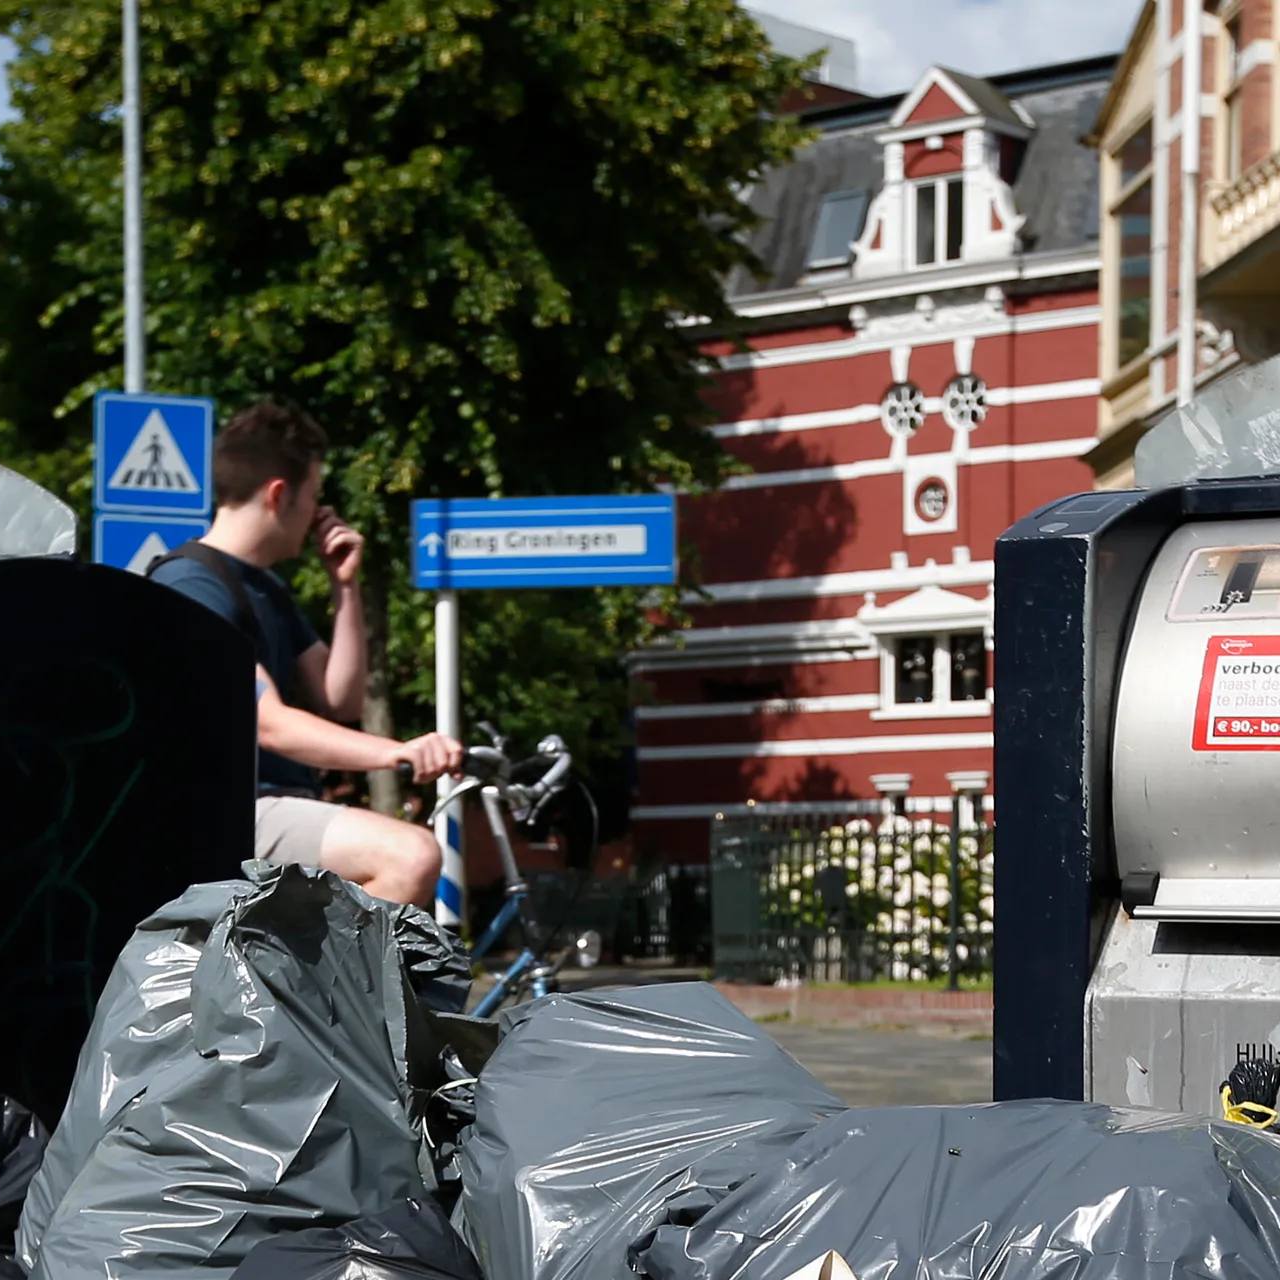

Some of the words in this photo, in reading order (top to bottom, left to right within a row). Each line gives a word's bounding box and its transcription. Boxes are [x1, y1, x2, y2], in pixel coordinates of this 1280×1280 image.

[450, 531, 498, 553] Ring
[504, 529, 617, 551] Groningen
[1218, 677, 1257, 691] naast
[1261, 677, 1280, 691] de
[1216, 694, 1231, 707] te
[1217, 721, 1229, 733] €
